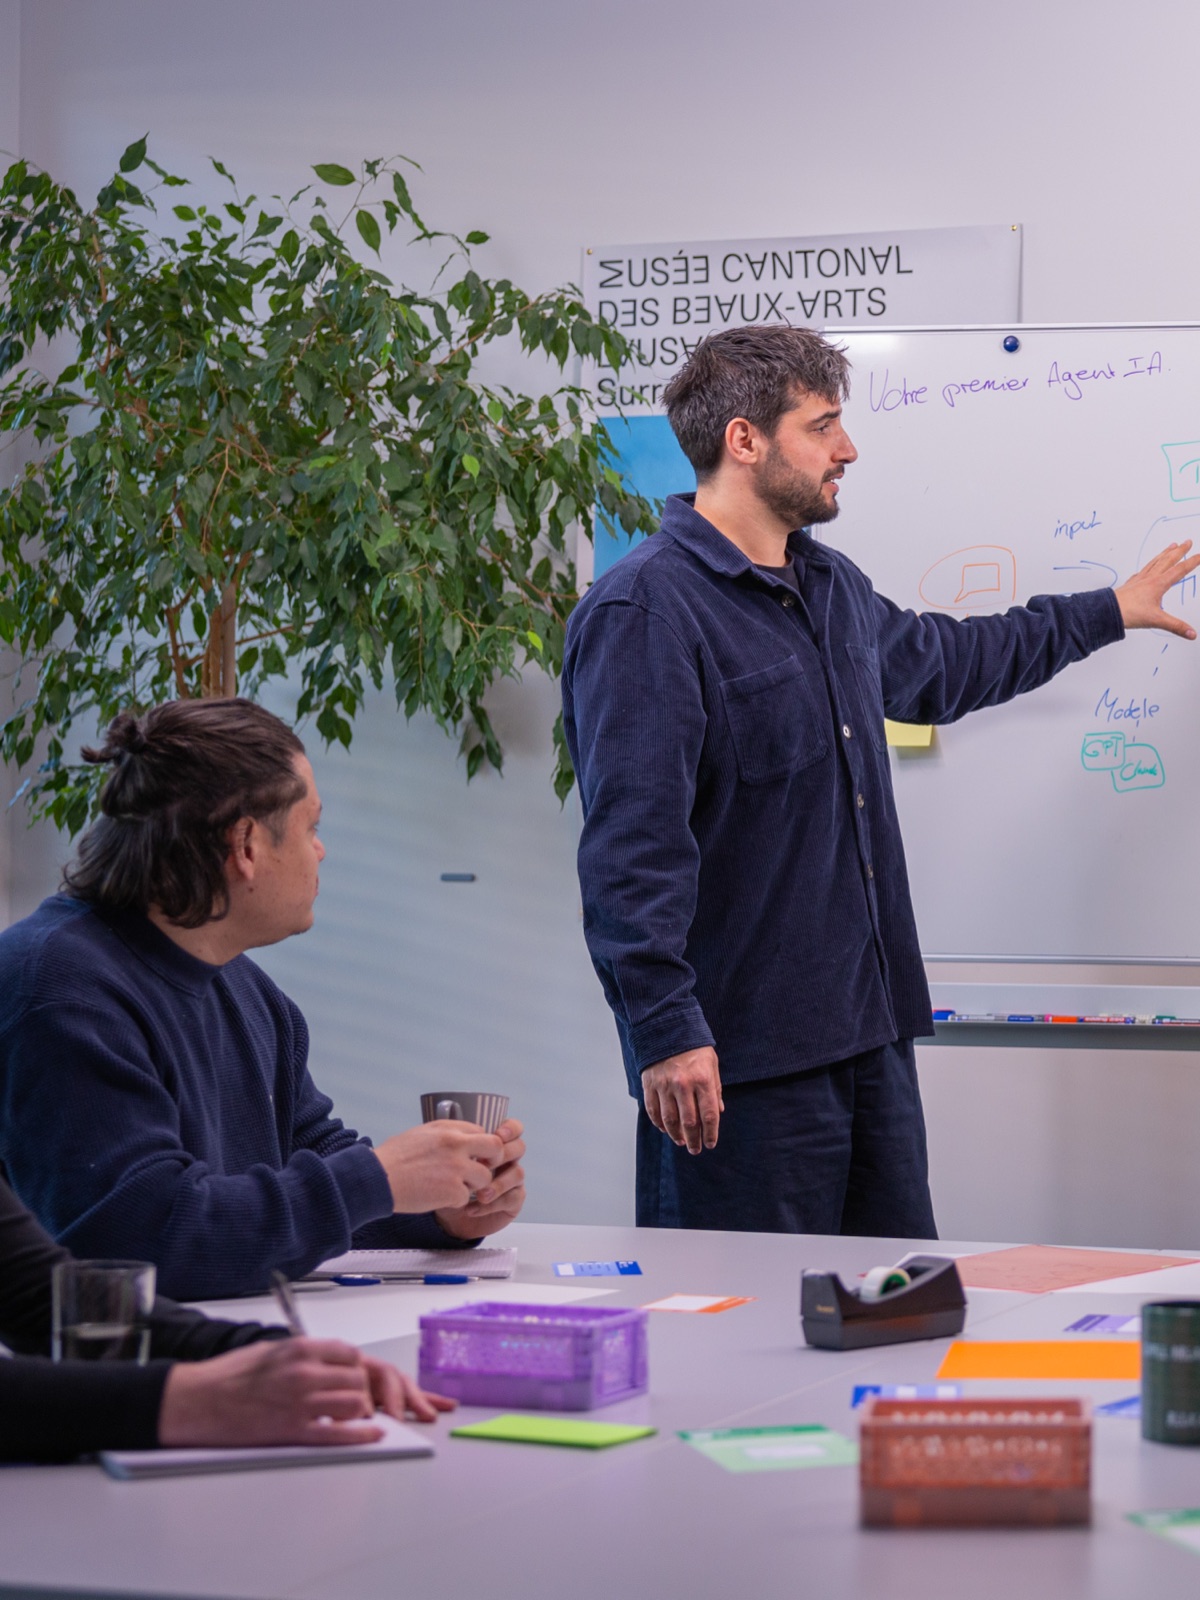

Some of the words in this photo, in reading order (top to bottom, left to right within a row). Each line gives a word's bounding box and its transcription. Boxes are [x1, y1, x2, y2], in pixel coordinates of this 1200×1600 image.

[599, 250, 710, 289] MUSÉE
[722, 245, 914, 283] CANTONAL
[599, 297, 660, 328] DES
[672, 287, 887, 325] BEAUX-ARTS
[870, 368, 928, 412] Votre
[942, 376, 1029, 407] premier
[1047, 361, 1115, 400] Agent
[1053, 510, 1102, 540] input
[1082, 735, 1124, 758] GPT
